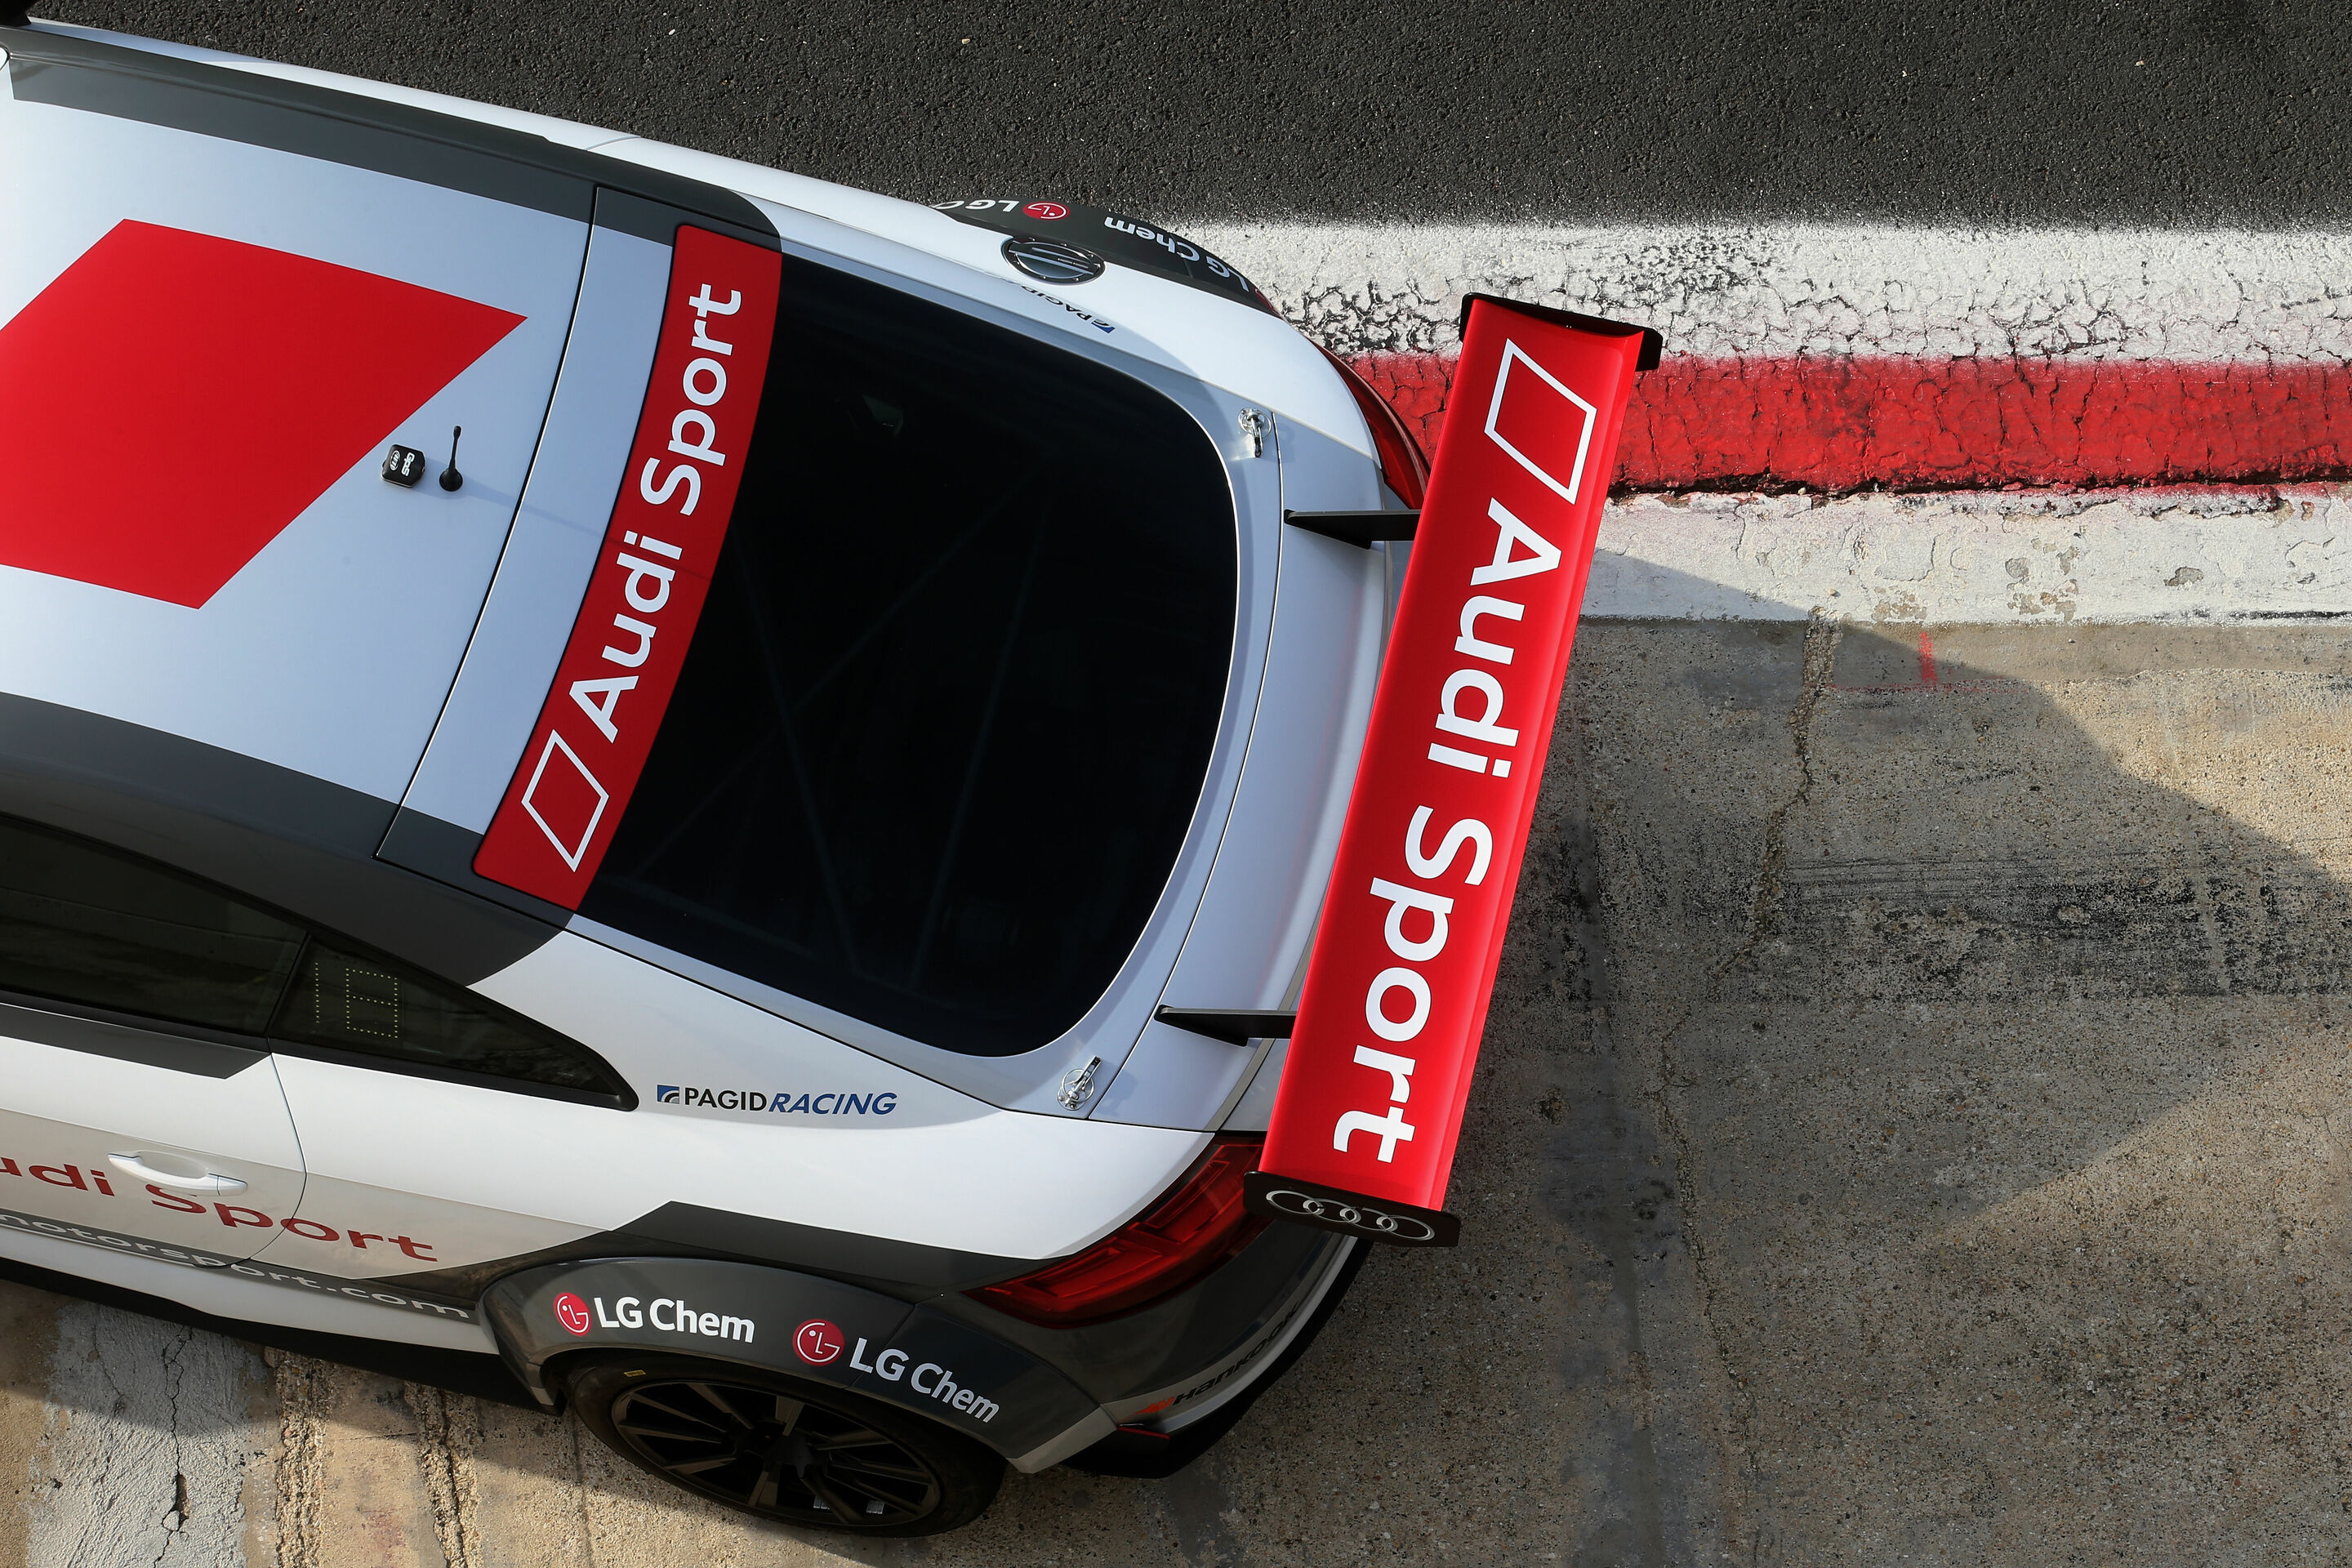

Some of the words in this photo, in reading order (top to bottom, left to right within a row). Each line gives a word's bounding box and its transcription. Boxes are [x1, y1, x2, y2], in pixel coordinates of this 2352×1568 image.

[965, 199, 1020, 212] LG
[1104, 216, 1200, 262] Chem
[1206, 256, 1250, 292] LG
[568, 531, 684, 744] Audi
[639, 283, 742, 516] Sport
[1426, 497, 1562, 779] Audi
[1333, 804, 1494, 1163] Sport
[145, 1183, 439, 1263] Sport
[594, 1296, 644, 1329] LG
[649, 1298, 755, 1343] Chem
[849, 1337, 910, 1382] LG
[911, 1362, 1000, 1423] Chem
